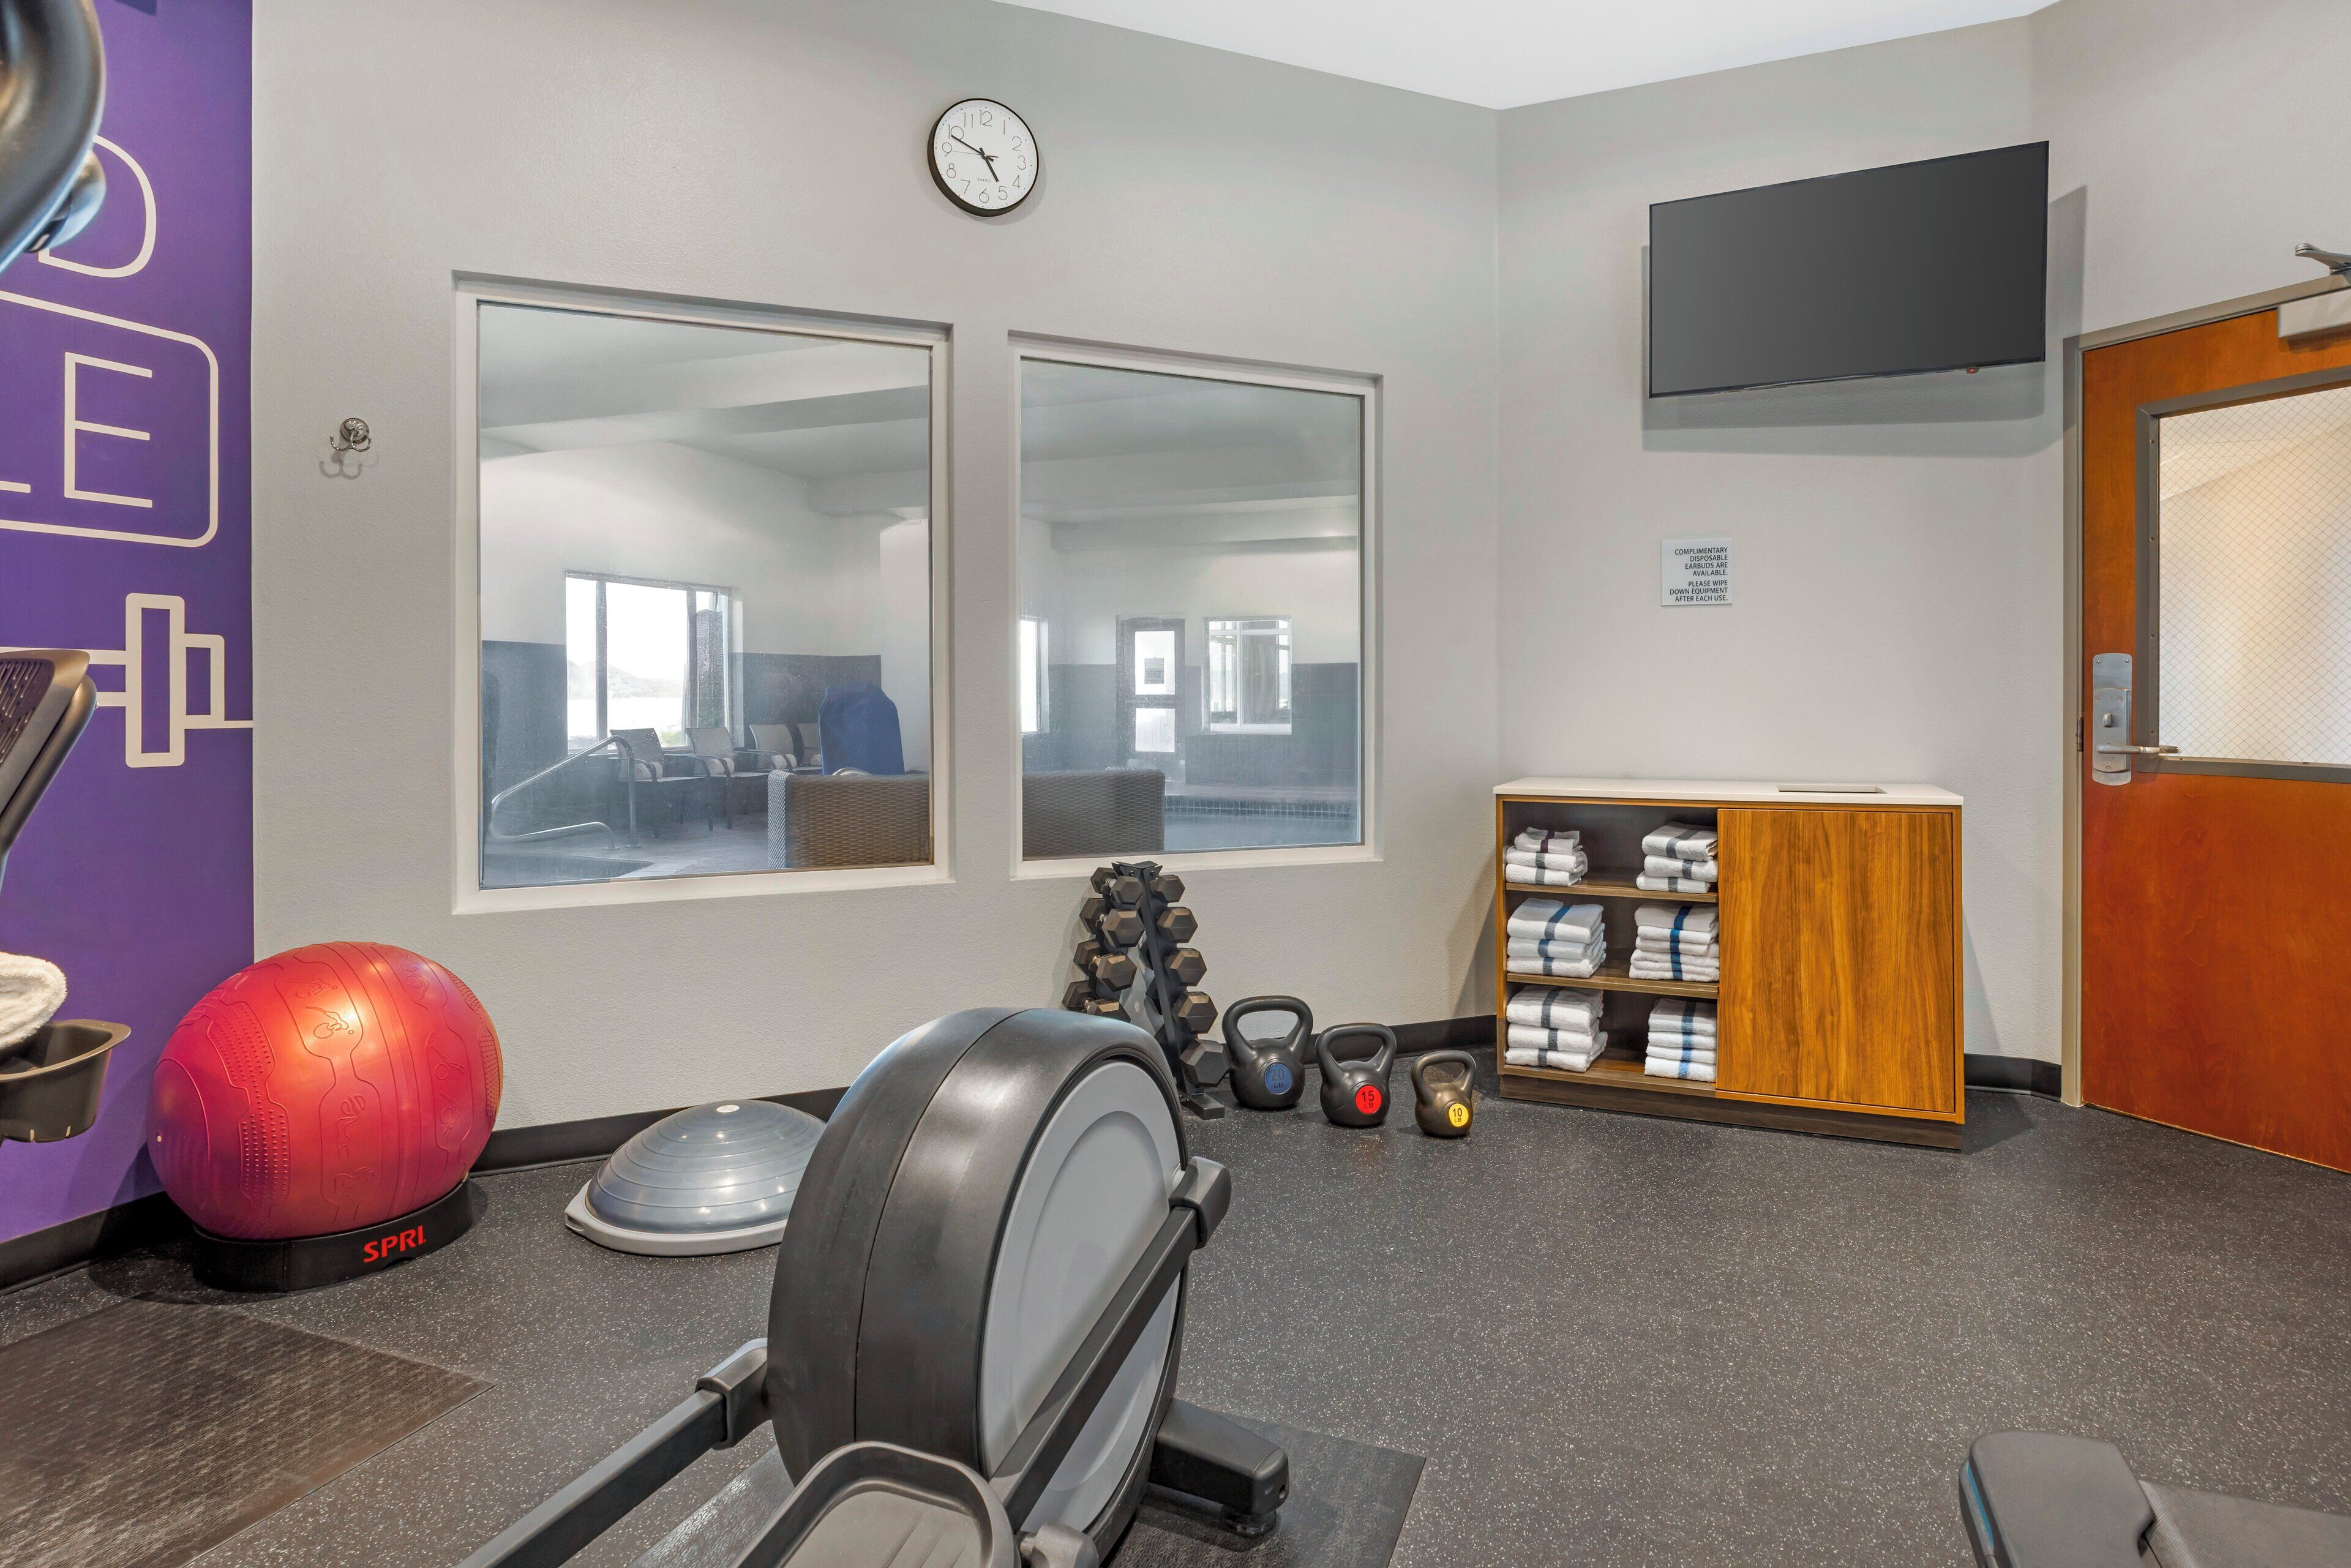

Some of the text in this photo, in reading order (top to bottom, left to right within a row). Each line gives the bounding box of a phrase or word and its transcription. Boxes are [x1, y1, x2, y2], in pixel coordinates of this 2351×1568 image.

[963, 113, 973, 129] 11
[980, 110, 992, 127] 12
[948, 124, 964, 140] 10
[942, 142, 953, 157] 9
[1011, 136, 1022, 152] 2
[1017, 155, 1026, 170] 3
[947, 163, 956, 178] 8
[960, 179, 970, 195] 7
[1012, 174, 1021, 189] 4
[979, 188, 989, 203] 6
[998, 186, 1008, 201] 5
[1674, 547, 1728, 555] COMPLIMENTARY
[1271, 1068, 1285, 1081] 20
[1361, 1090, 1374, 1102] 15
[1452, 1108, 1463, 1117] 10
[363, 1225, 424, 1262] SPRI
